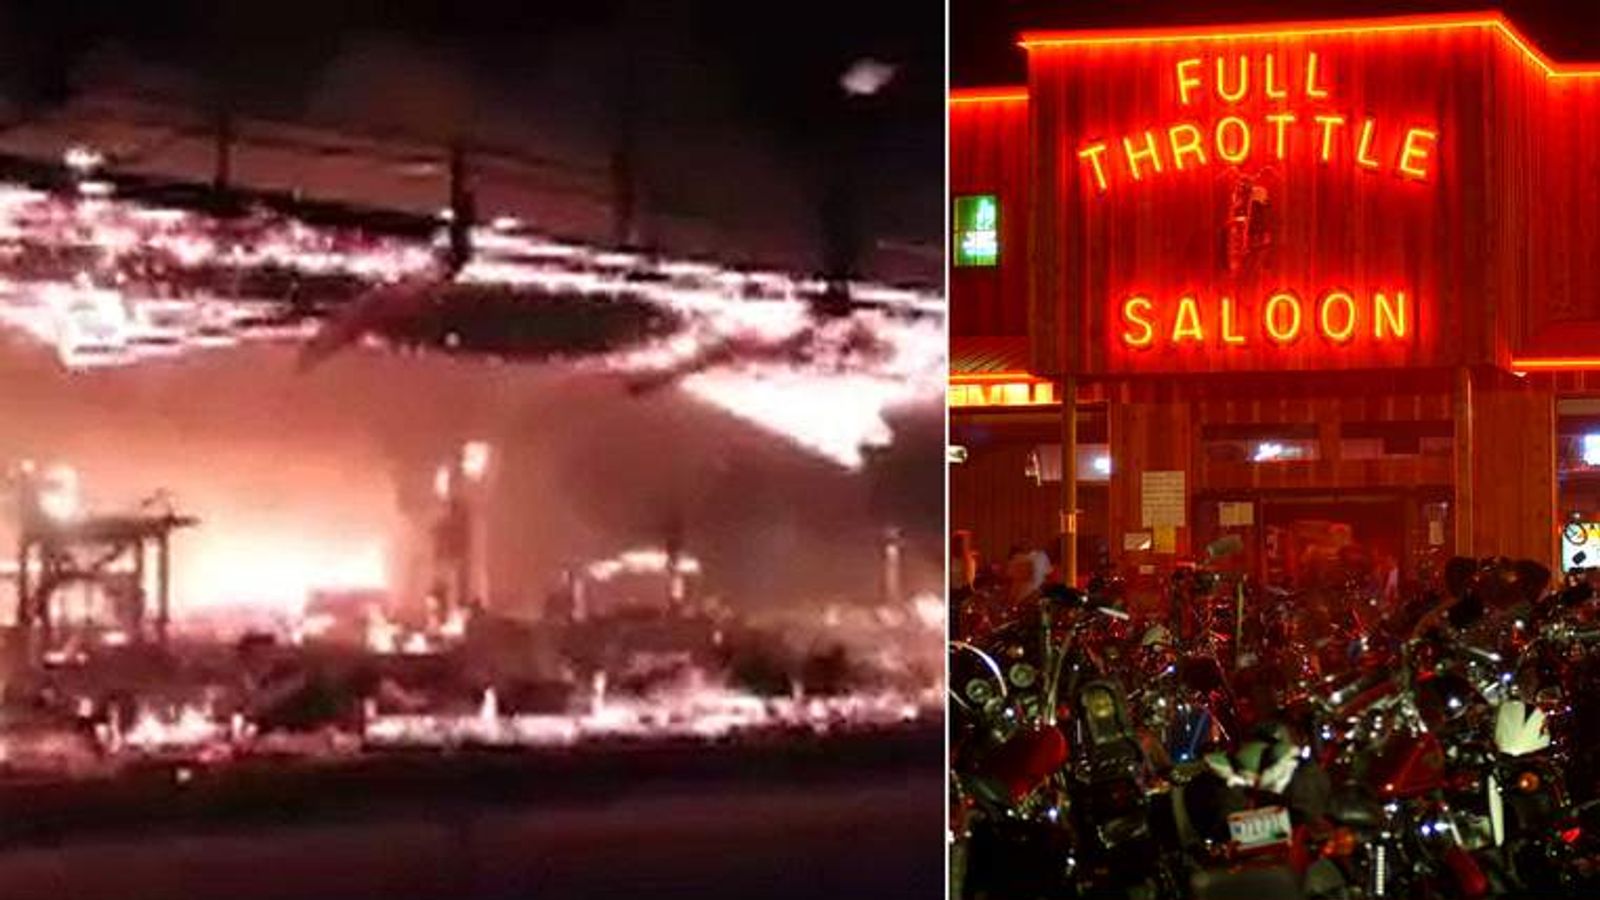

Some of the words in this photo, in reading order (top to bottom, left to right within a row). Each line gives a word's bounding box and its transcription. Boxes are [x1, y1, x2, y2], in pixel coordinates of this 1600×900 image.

[1176, 52, 1328, 104] FULL
[1079, 114, 1438, 191] THROTTLE
[1123, 292, 1406, 345] SALOON
